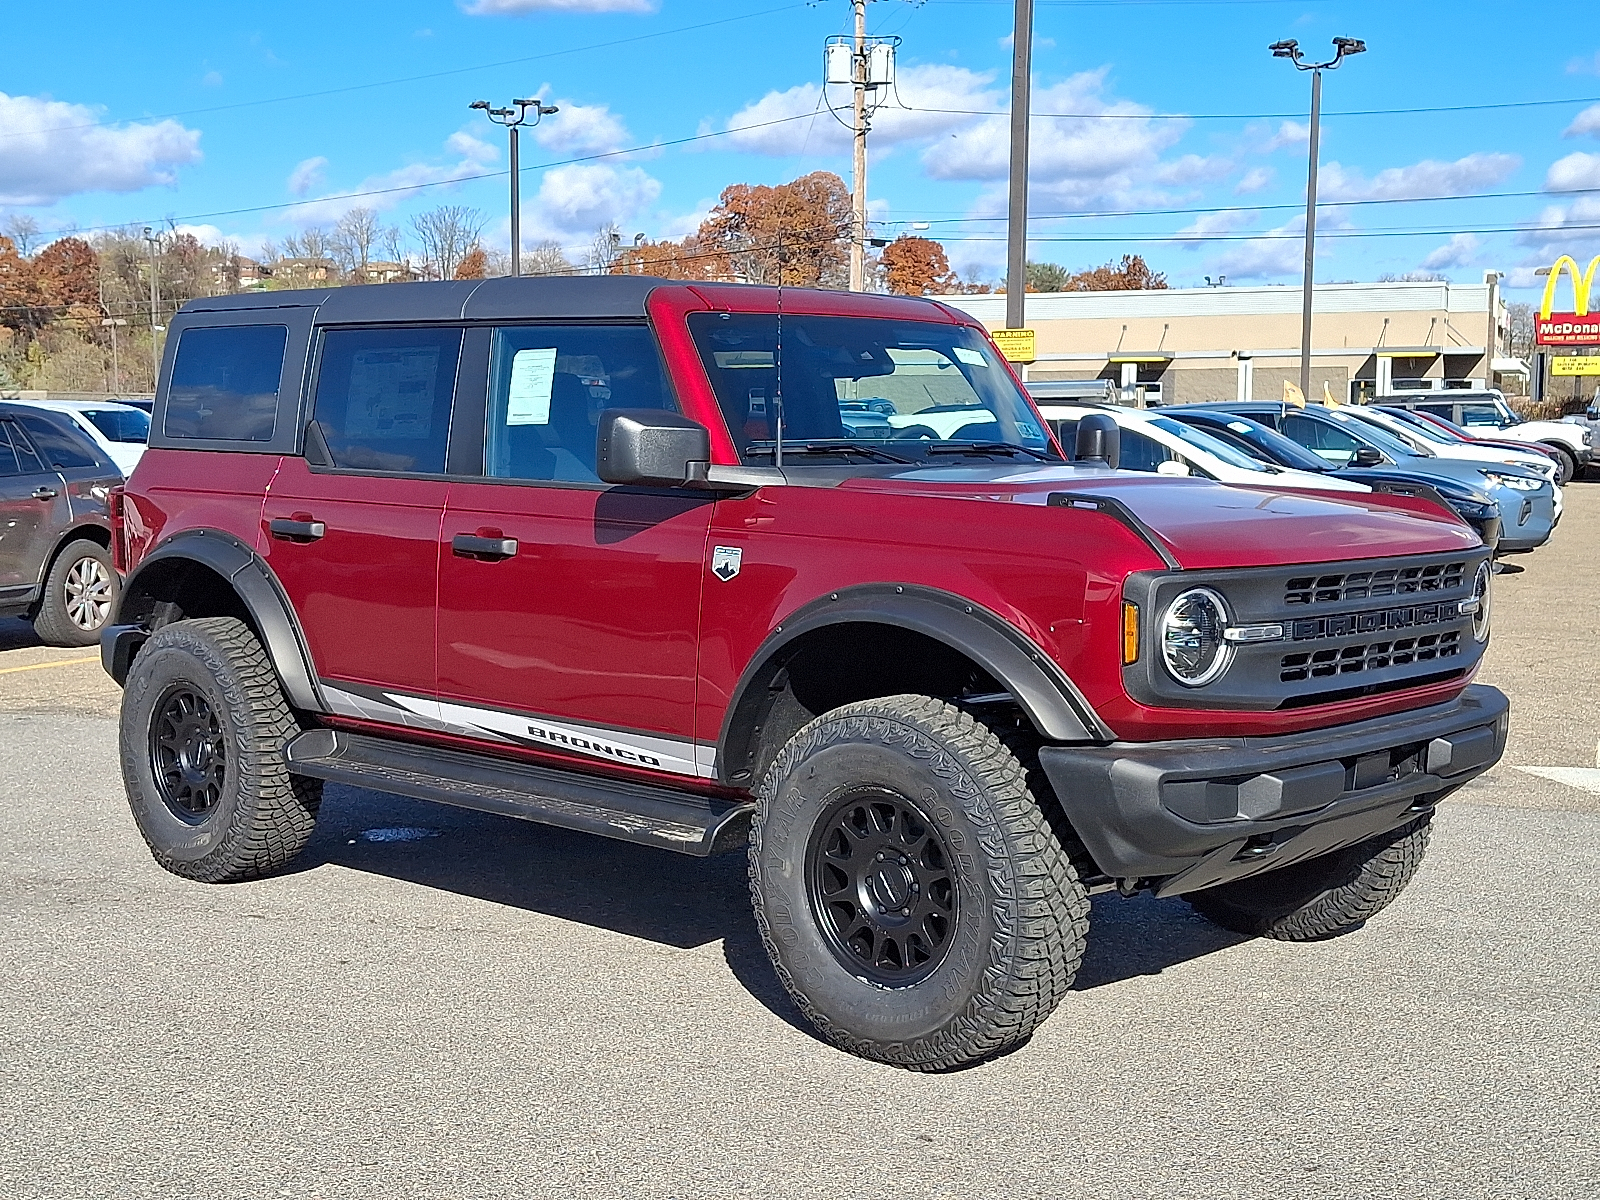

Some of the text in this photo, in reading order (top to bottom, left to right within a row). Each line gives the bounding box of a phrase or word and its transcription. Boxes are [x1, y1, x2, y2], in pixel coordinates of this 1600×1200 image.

[1540, 323, 1600, 335] McDona
[1294, 602, 1459, 638] BRONCO
[527, 725, 661, 767] BRONCO
